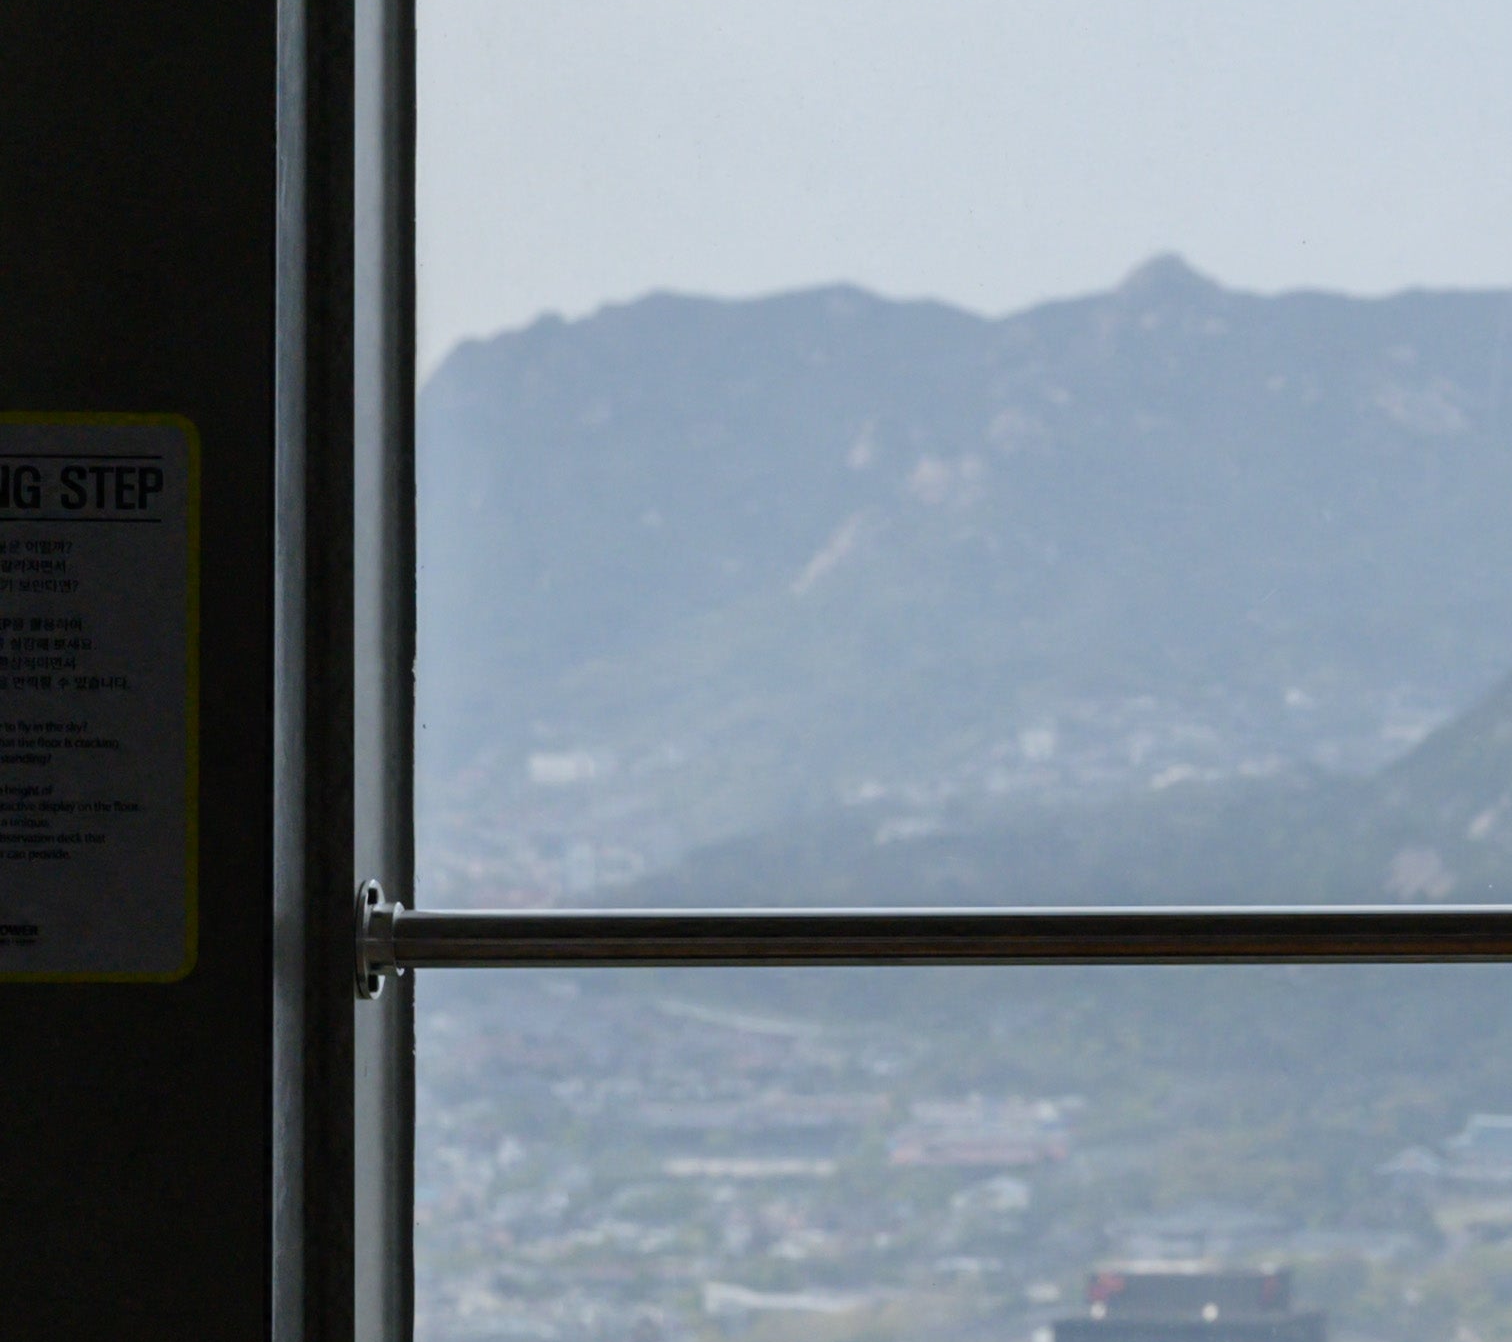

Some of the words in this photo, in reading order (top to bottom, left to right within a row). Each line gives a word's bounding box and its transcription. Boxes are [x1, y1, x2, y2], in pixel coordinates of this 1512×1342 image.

[60, 465, 164, 510] STEP
[74, 675, 131, 691] 있습니다.
[45, 720, 63, 733] the
[94, 800, 111, 812] the
